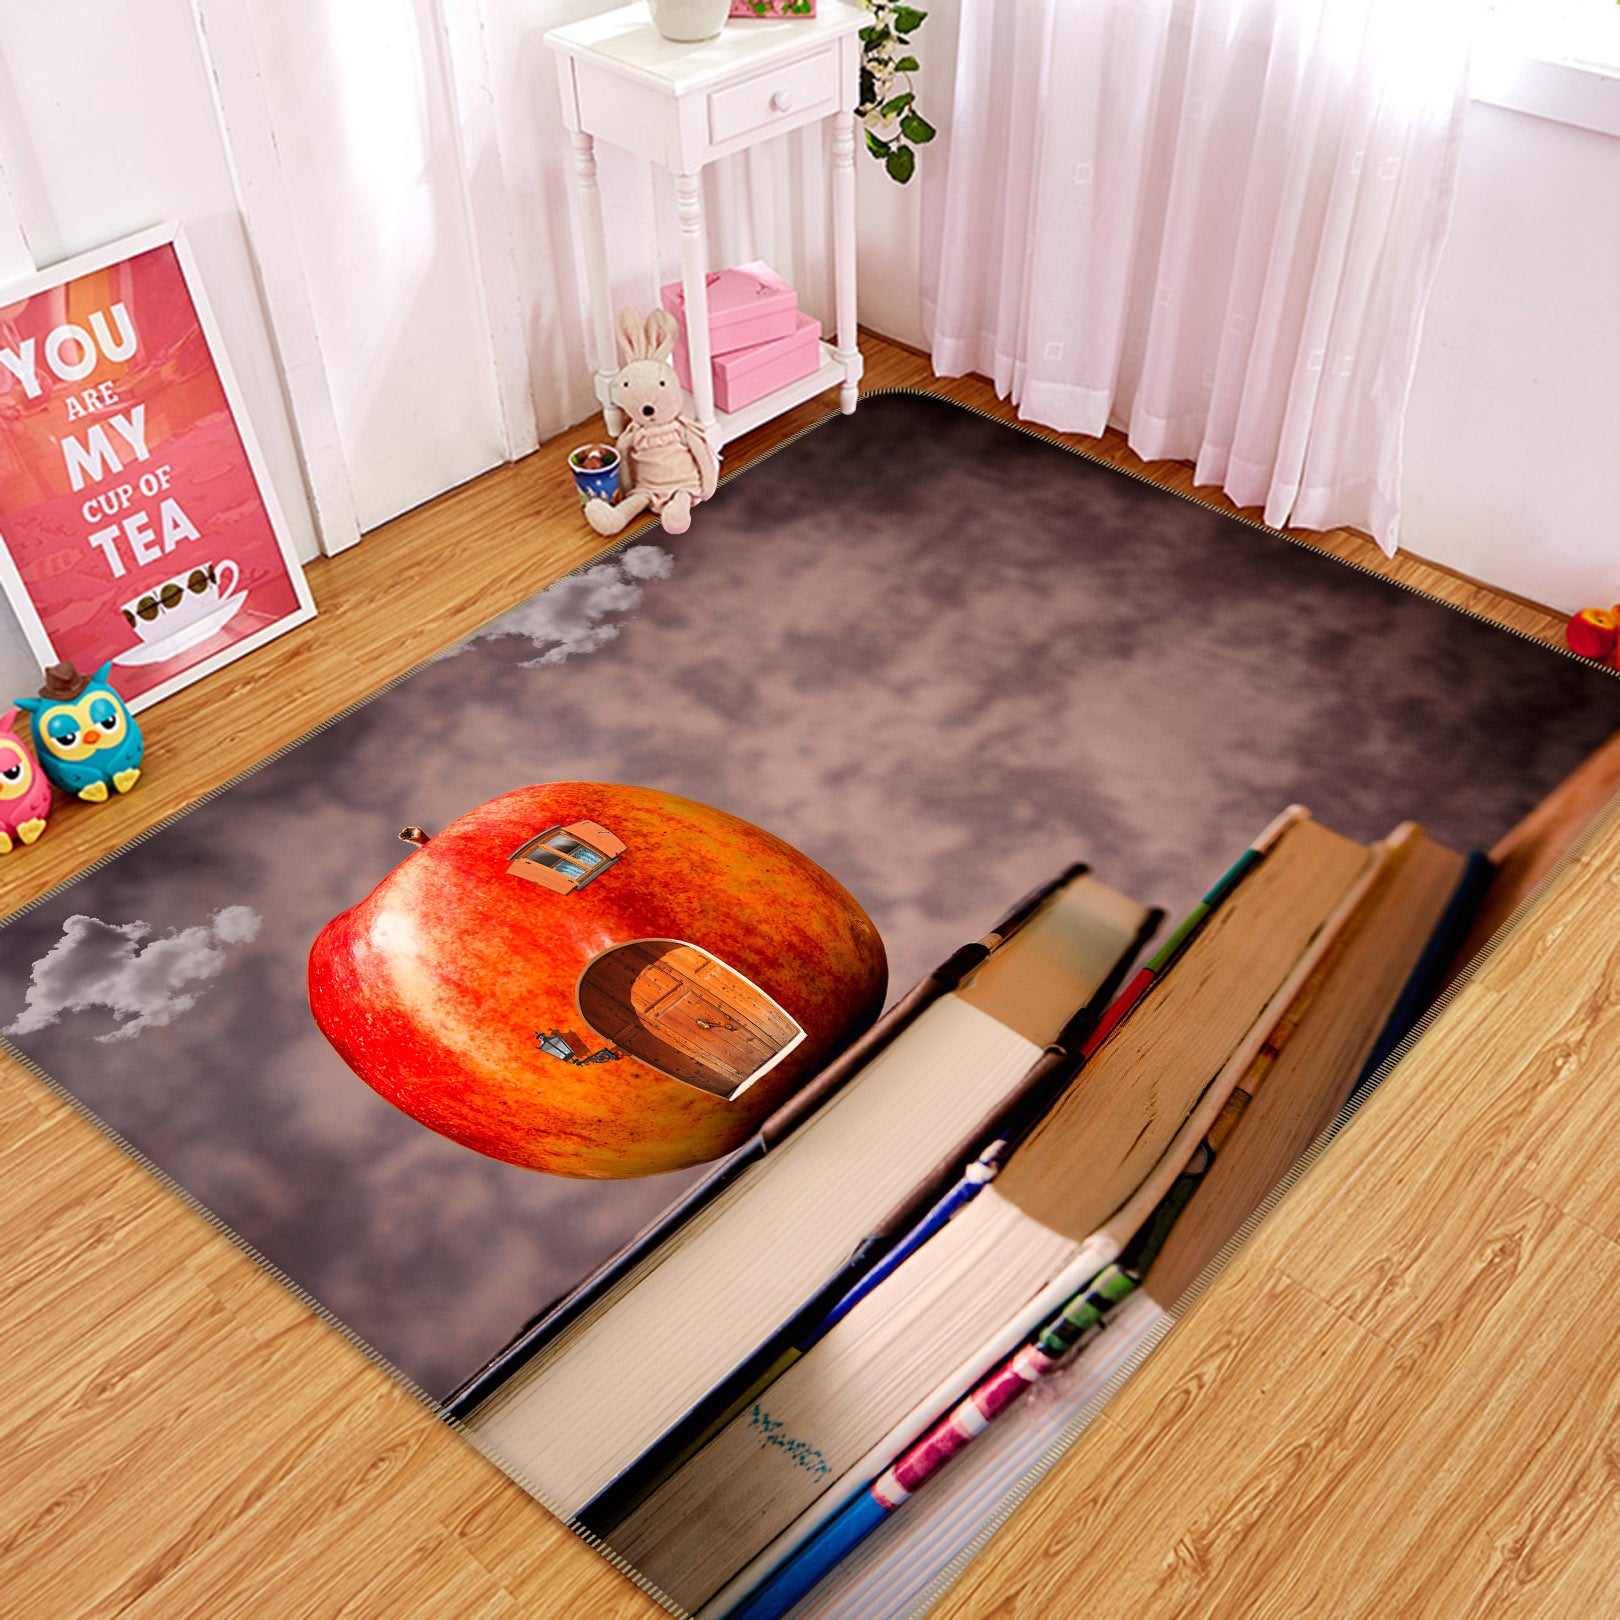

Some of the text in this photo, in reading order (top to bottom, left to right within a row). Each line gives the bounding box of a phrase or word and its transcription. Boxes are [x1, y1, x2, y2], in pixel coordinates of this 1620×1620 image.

[0, 303, 137, 399] YOU
[66, 381, 119, 421] ARE
[61, 404, 150, 492] MY
[82, 465, 172, 523] CUP OF
[89, 498, 200, 578] TEA
